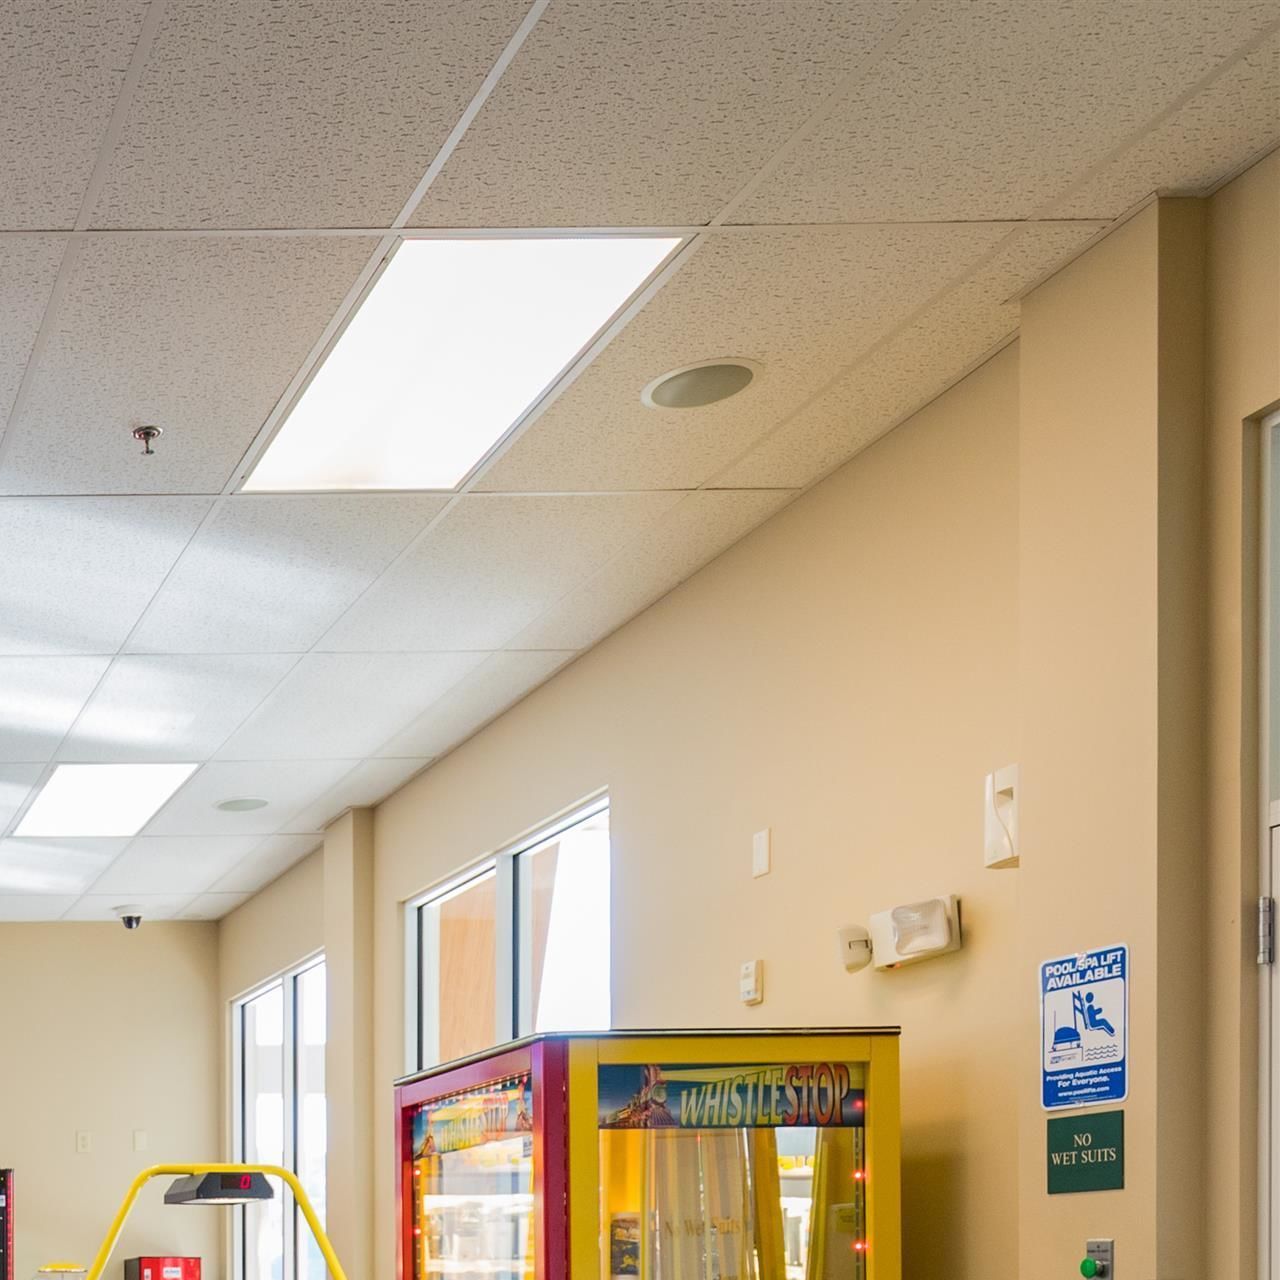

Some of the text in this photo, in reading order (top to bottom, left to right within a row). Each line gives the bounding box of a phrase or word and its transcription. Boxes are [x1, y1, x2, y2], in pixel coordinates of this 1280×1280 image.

[1046, 951, 1123, 977] POOL/SPA LIFT
[1047, 964, 1122, 990] AVAILABLE
[1046, 1073, 1074, 1083] Providing
[1099, 1066, 1122, 1075] Access
[1058, 1079, 1071, 1088] For
[1073, 1133, 1092, 1148] NO
[1052, 1148, 1117, 1166] WET SUITS
